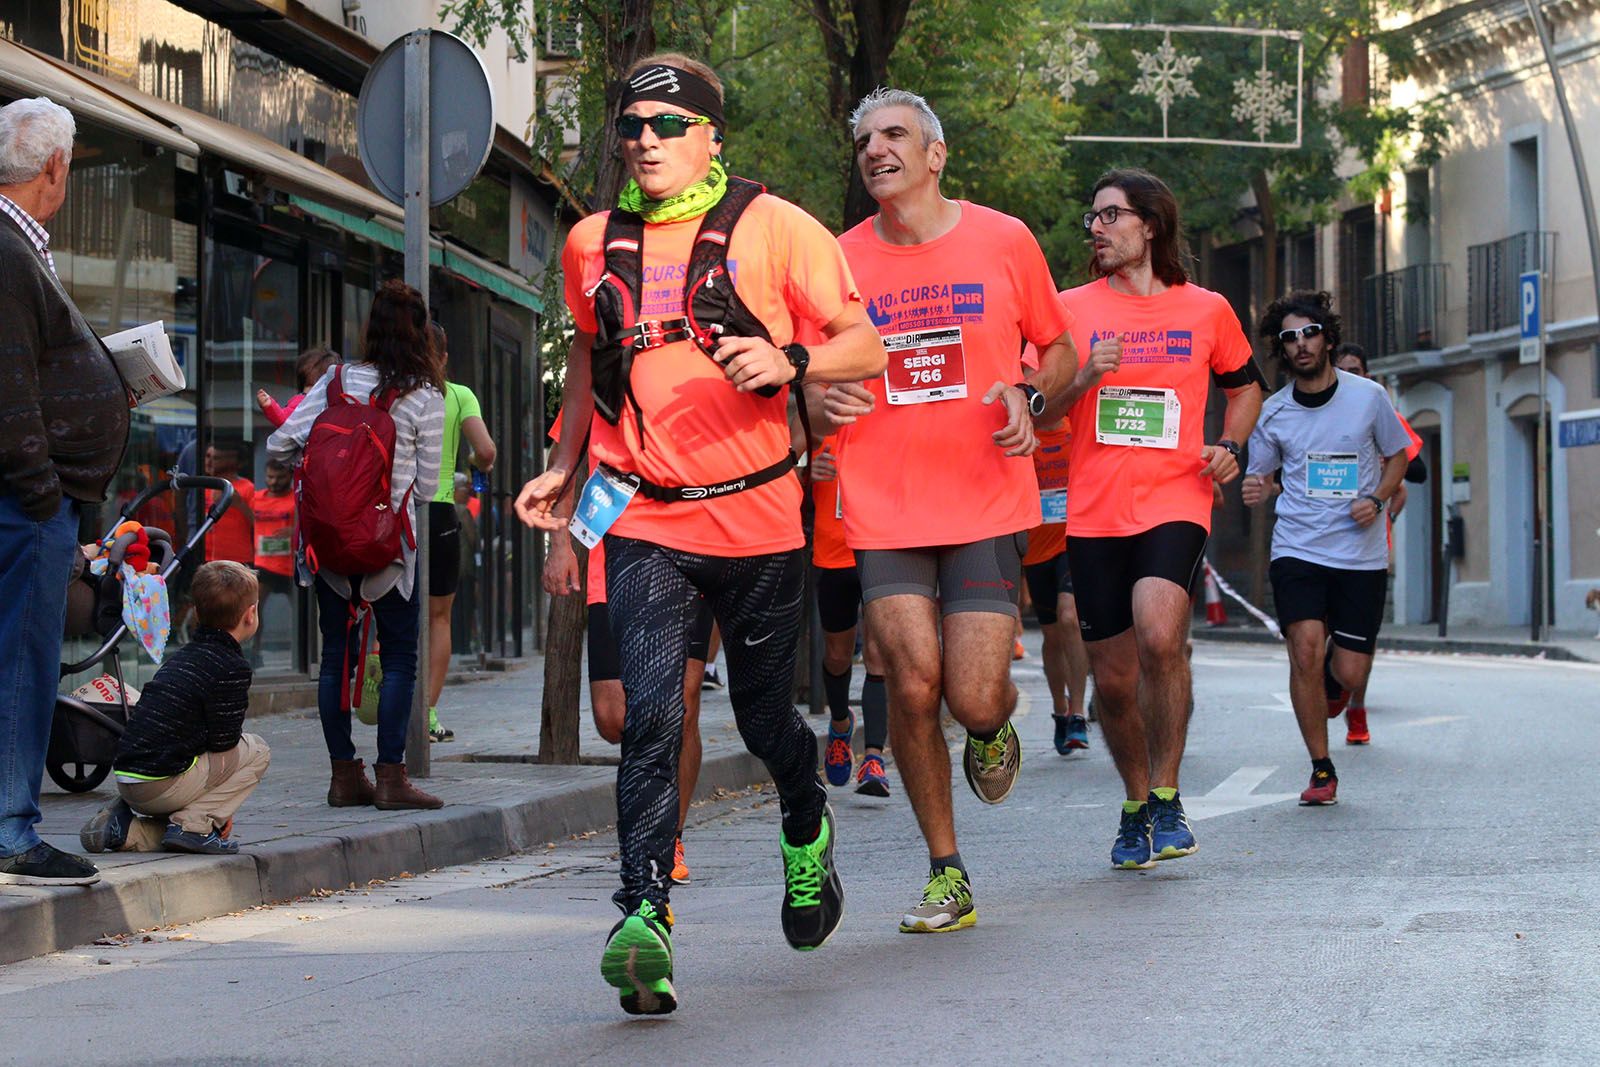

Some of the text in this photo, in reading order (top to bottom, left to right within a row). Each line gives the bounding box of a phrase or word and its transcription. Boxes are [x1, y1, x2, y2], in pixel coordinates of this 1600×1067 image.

[901, 284, 950, 304] CURSA
[954, 292, 983, 305] DiR
[1522, 281, 1536, 332] P
[906, 334, 920, 345] DiR
[1122, 331, 1164, 343] CURSA
[903, 354, 946, 369] SERGI
[910, 368, 943, 385] 766
[1118, 407, 1144, 418] PAU
[1115, 419, 1146, 431] 1732
[1317, 467, 1347, 476] MARTÍ
[708, 479, 746, 496] Kalenji
[1322, 478, 1342, 486] 377
